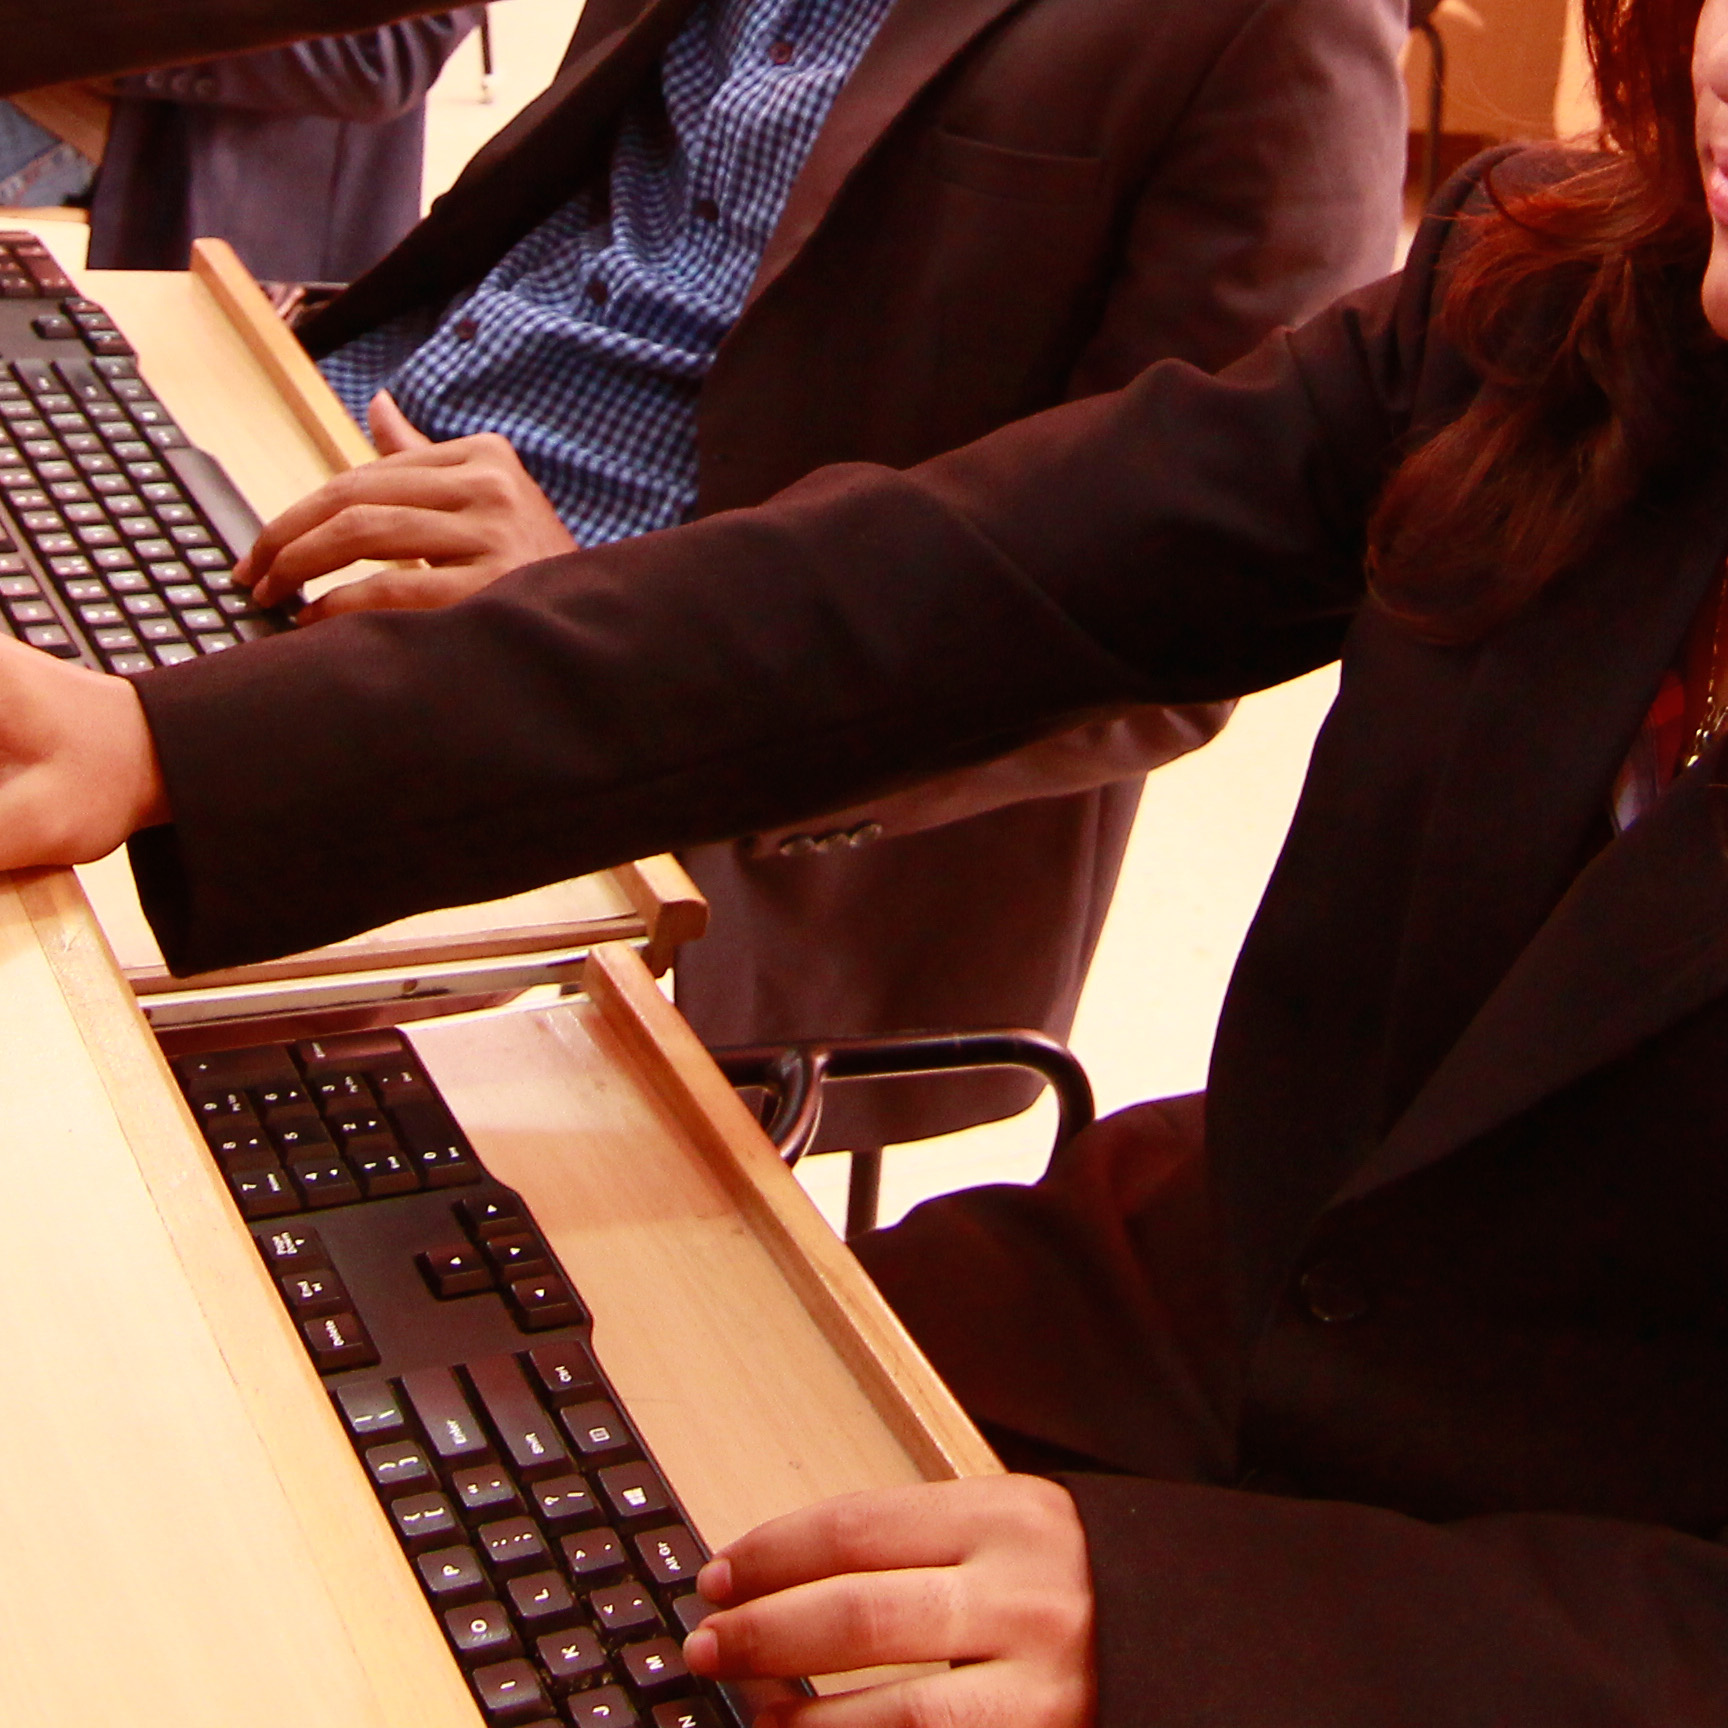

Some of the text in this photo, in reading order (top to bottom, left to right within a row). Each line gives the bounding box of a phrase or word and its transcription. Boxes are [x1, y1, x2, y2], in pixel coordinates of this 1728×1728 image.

[443, 1565, 460, 1577] P
[534, 1588, 549, 1601] L
[561, 1645, 580, 1660] K
[645, 1655, 665, 1670] M
[592, 1705, 610, 1716] J
[678, 1715, 697, 1728] N
